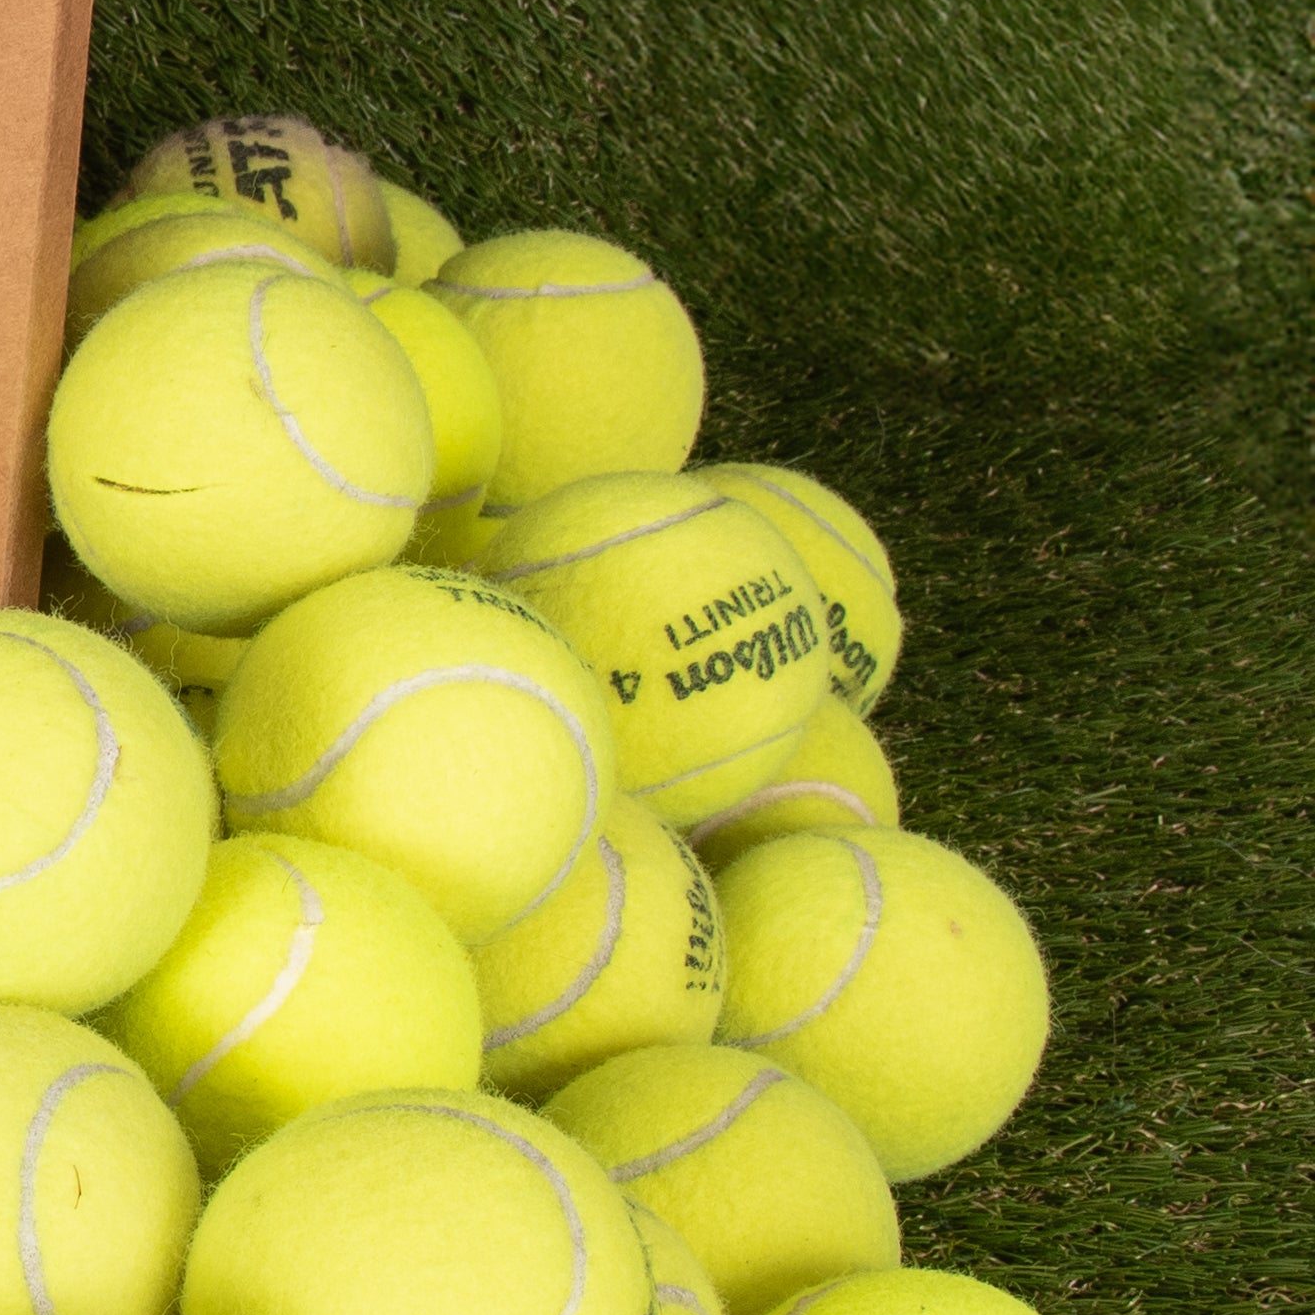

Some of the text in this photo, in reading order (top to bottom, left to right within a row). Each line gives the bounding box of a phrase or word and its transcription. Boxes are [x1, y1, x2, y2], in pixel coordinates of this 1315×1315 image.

[665, 569, 793, 650] TRINITI
[610, 669, 642, 705] 4
[665, 604, 819, 701] Wilson
